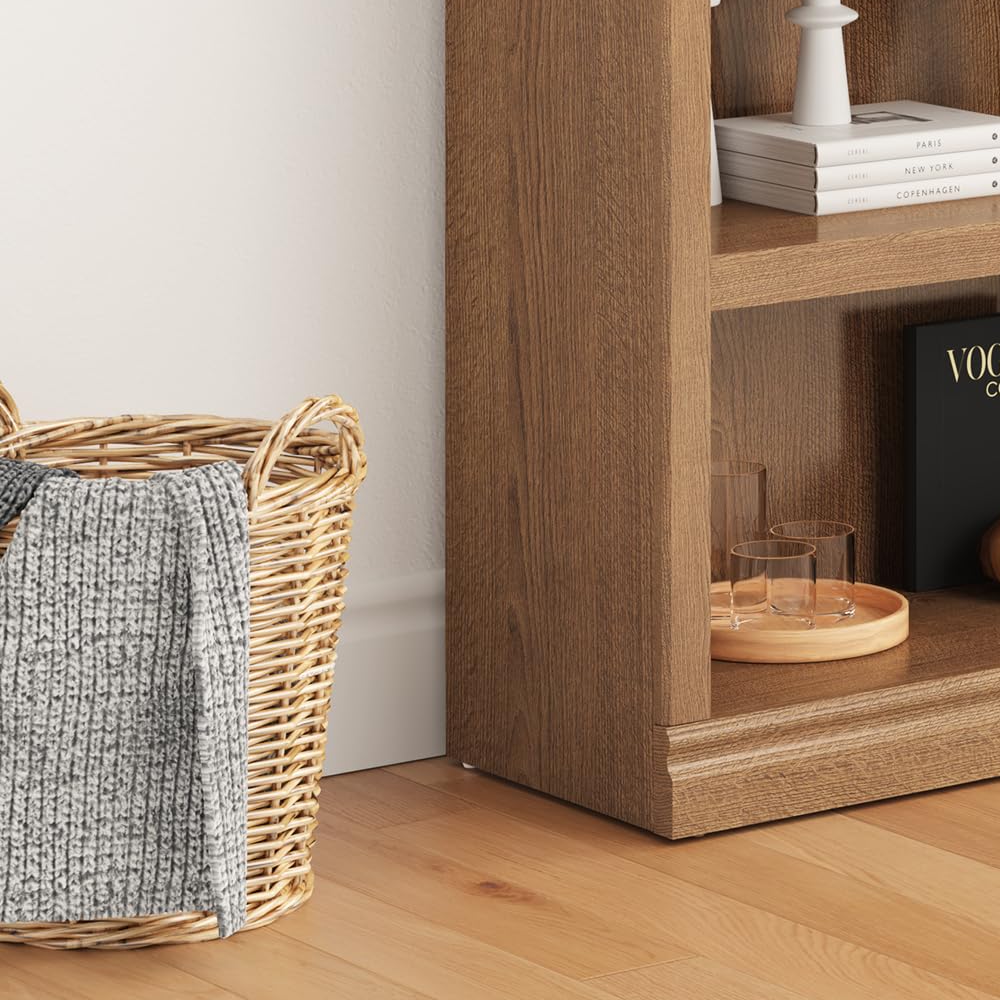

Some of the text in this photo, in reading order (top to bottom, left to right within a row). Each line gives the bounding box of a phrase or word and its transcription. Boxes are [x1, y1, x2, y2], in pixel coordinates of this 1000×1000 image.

[916, 138, 942, 149] PARIS
[904, 162, 954, 175] NEW YORK
[896, 185, 961, 200] COPENHAGEN
